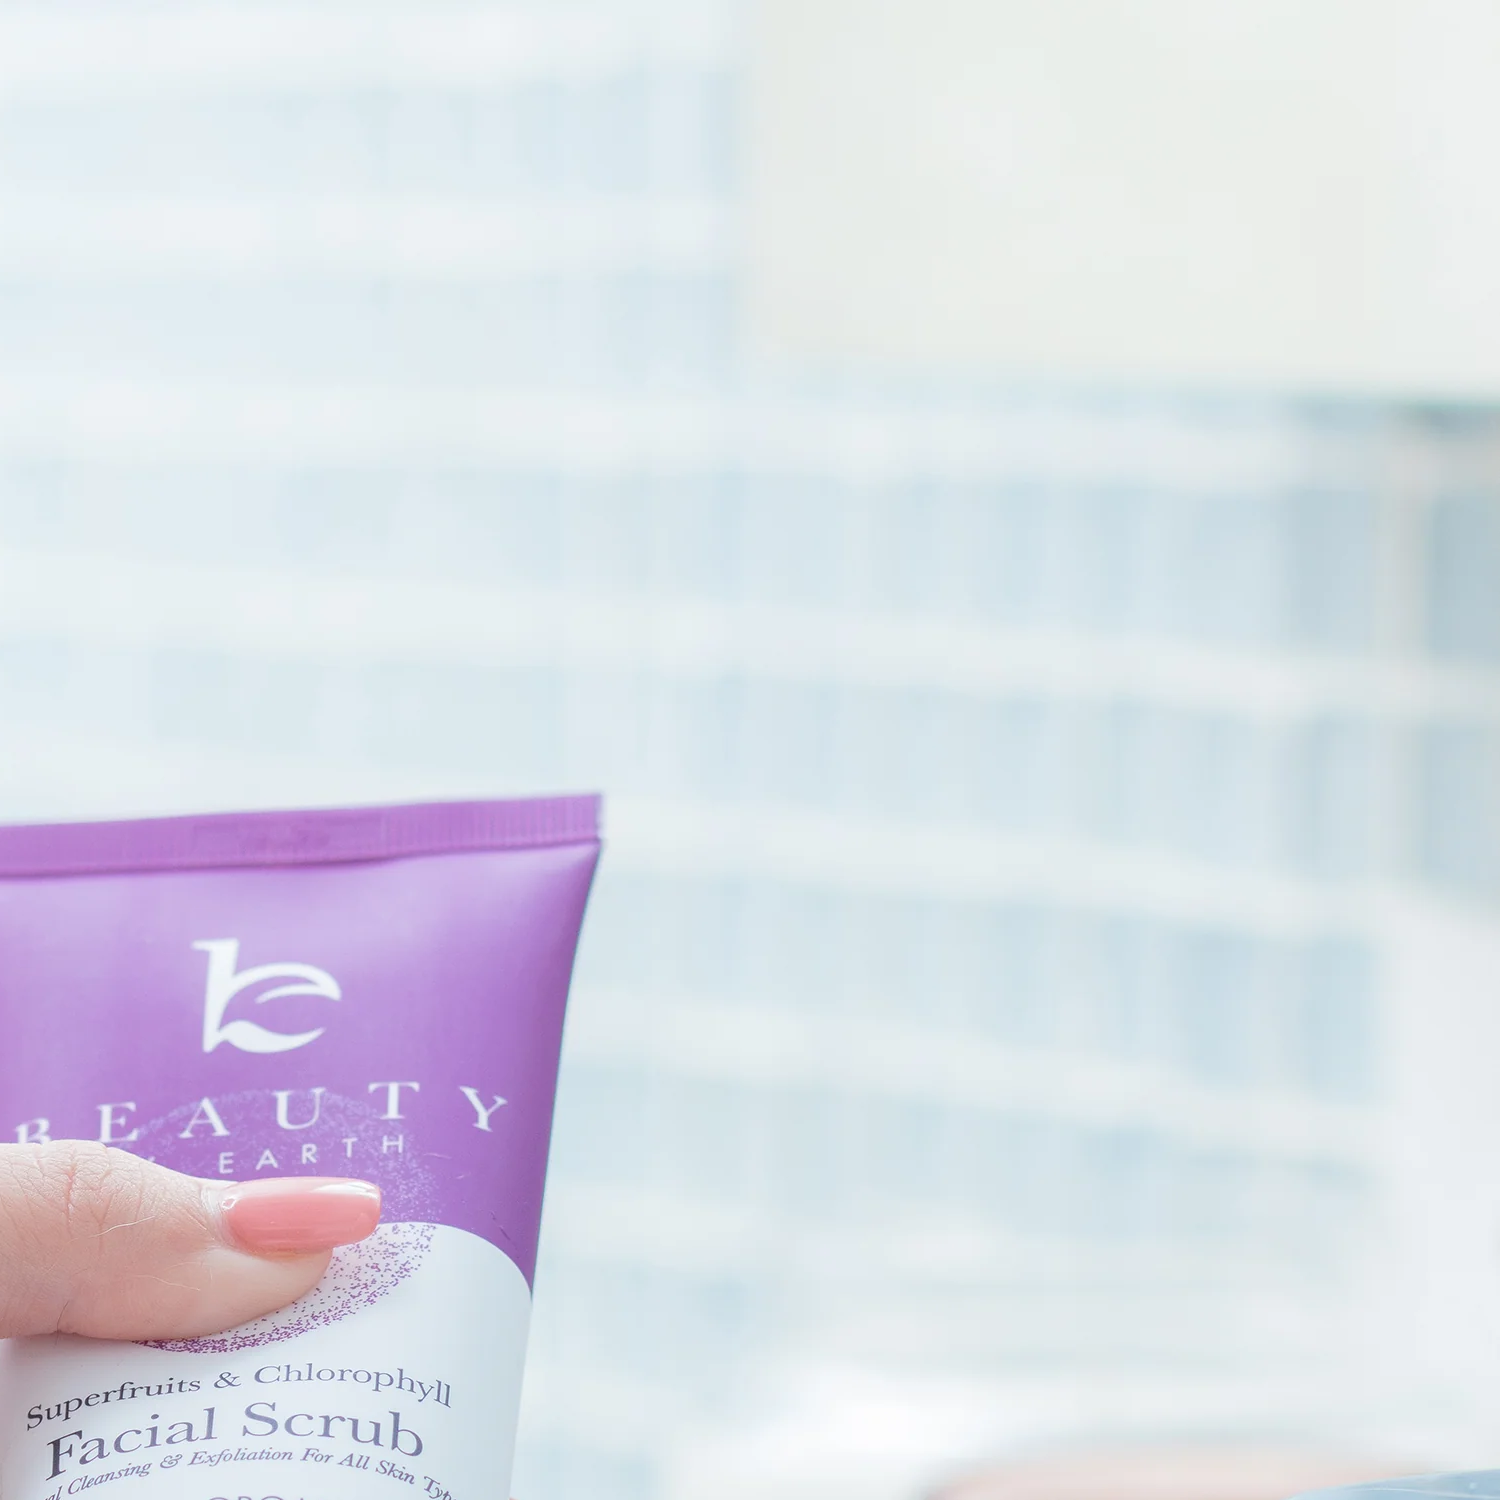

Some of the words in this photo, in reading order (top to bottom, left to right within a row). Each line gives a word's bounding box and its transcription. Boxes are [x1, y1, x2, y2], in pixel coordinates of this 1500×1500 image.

[14, 1080, 508, 1147] BEAUTY
[219, 1134, 404, 1174] EARTH
[26, 1376, 202, 1431] Superfruits
[213, 1372, 242, 1389] &
[254, 1363, 452, 1409] Chlorophyll
[45, 1407, 218, 1481] Facial
[242, 1402, 424, 1459] Scrub
[68, 1460, 152, 1496] Cleansing
[160, 1454, 183, 1469] &
[188, 1447, 293, 1467] Exfoliation
[301, 1448, 334, 1463] For
[338, 1453, 370, 1471] All
[375, 1460, 416, 1485] Skin
